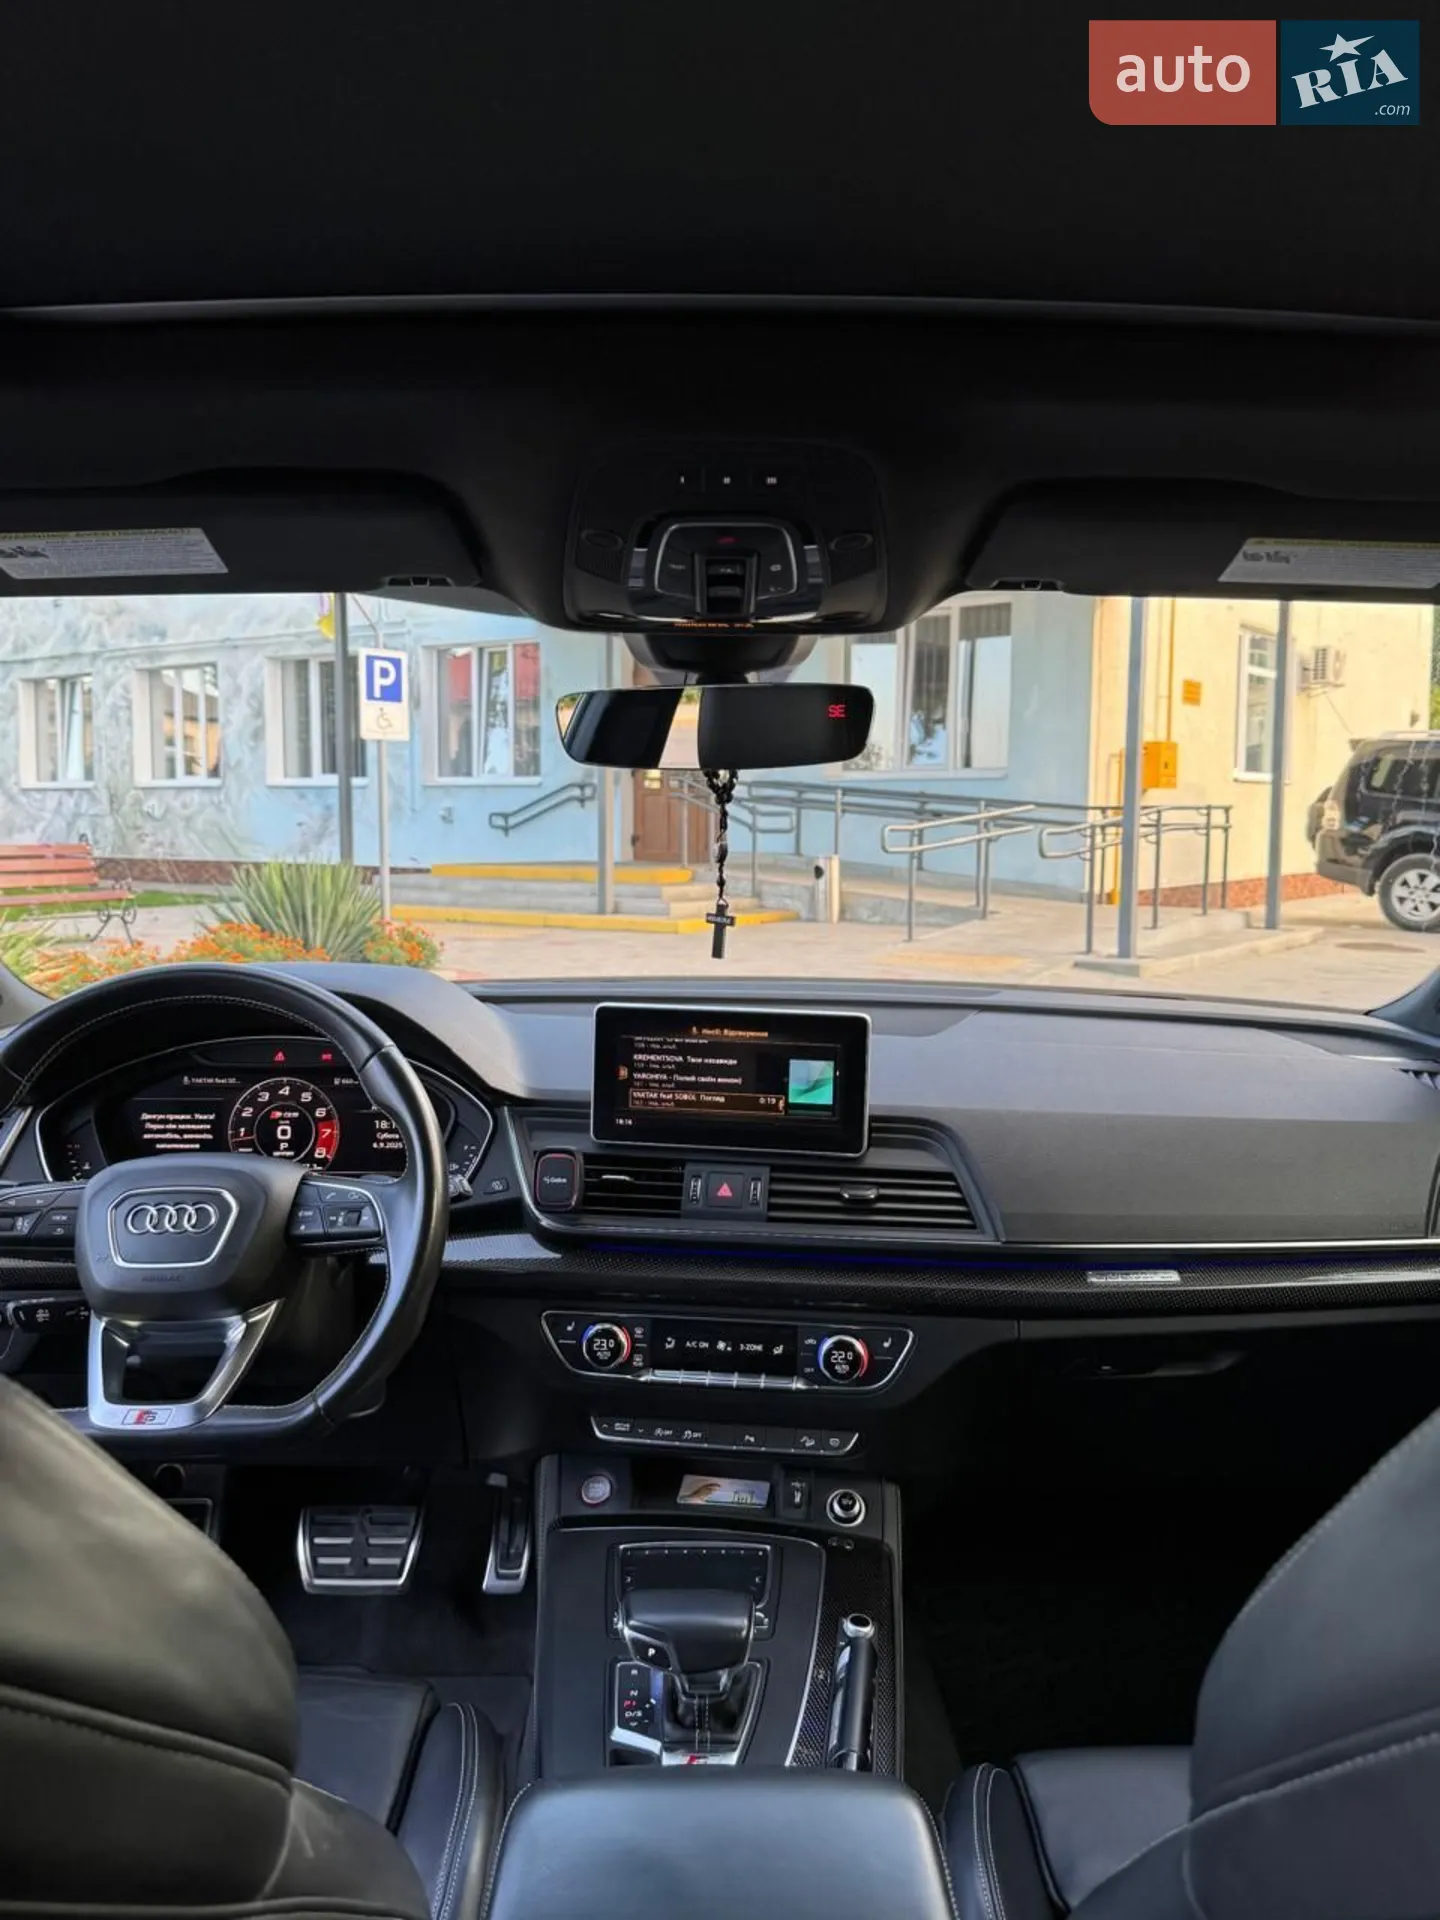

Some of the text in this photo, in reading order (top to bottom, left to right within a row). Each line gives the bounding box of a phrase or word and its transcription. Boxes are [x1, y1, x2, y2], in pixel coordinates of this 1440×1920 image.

[373, 660, 396, 698] P
[828, 704, 845, 717] SE
[278, 1086, 290, 1095] 4
[257, 1092, 270, 1101] 3
[301, 1092, 313, 1102] 5
[241, 1107, 253, 1117] 2
[315, 1108, 326, 1117] 6
[240, 1128, 245, 1136] 1
[277, 1125, 292, 1140] 0
[321, 1129, 331, 1138] 7
[280, 1142, 289, 1150] P
[314, 1147, 326, 1158] 8
[648, 1648, 656, 1656] P
